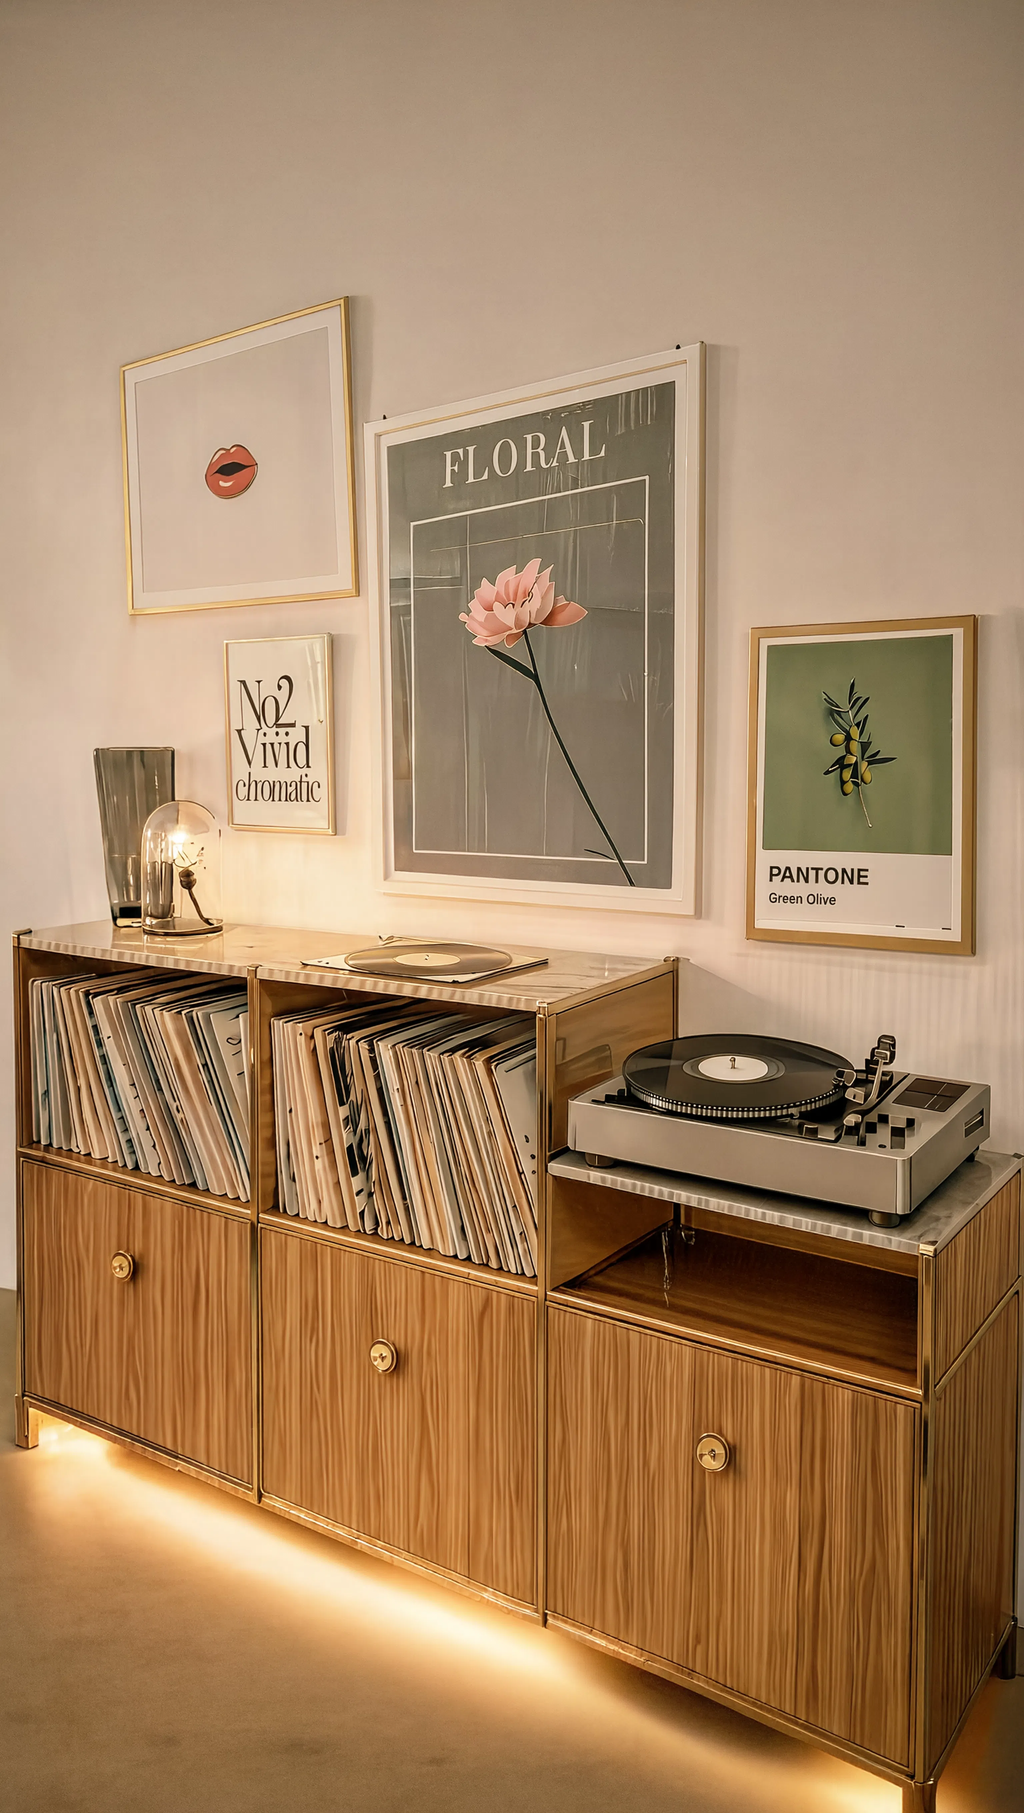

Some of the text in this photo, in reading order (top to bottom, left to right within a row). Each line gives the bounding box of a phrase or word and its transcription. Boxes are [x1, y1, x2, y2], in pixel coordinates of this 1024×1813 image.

[442, 420, 606, 489] FLORAL
[236, 674, 297, 730] No2
[235, 725, 312, 769] Vivid
[235, 771, 322, 803] chromatic
[768, 865, 870, 886] PANTONE
[768, 892, 837, 906] Green Olive
